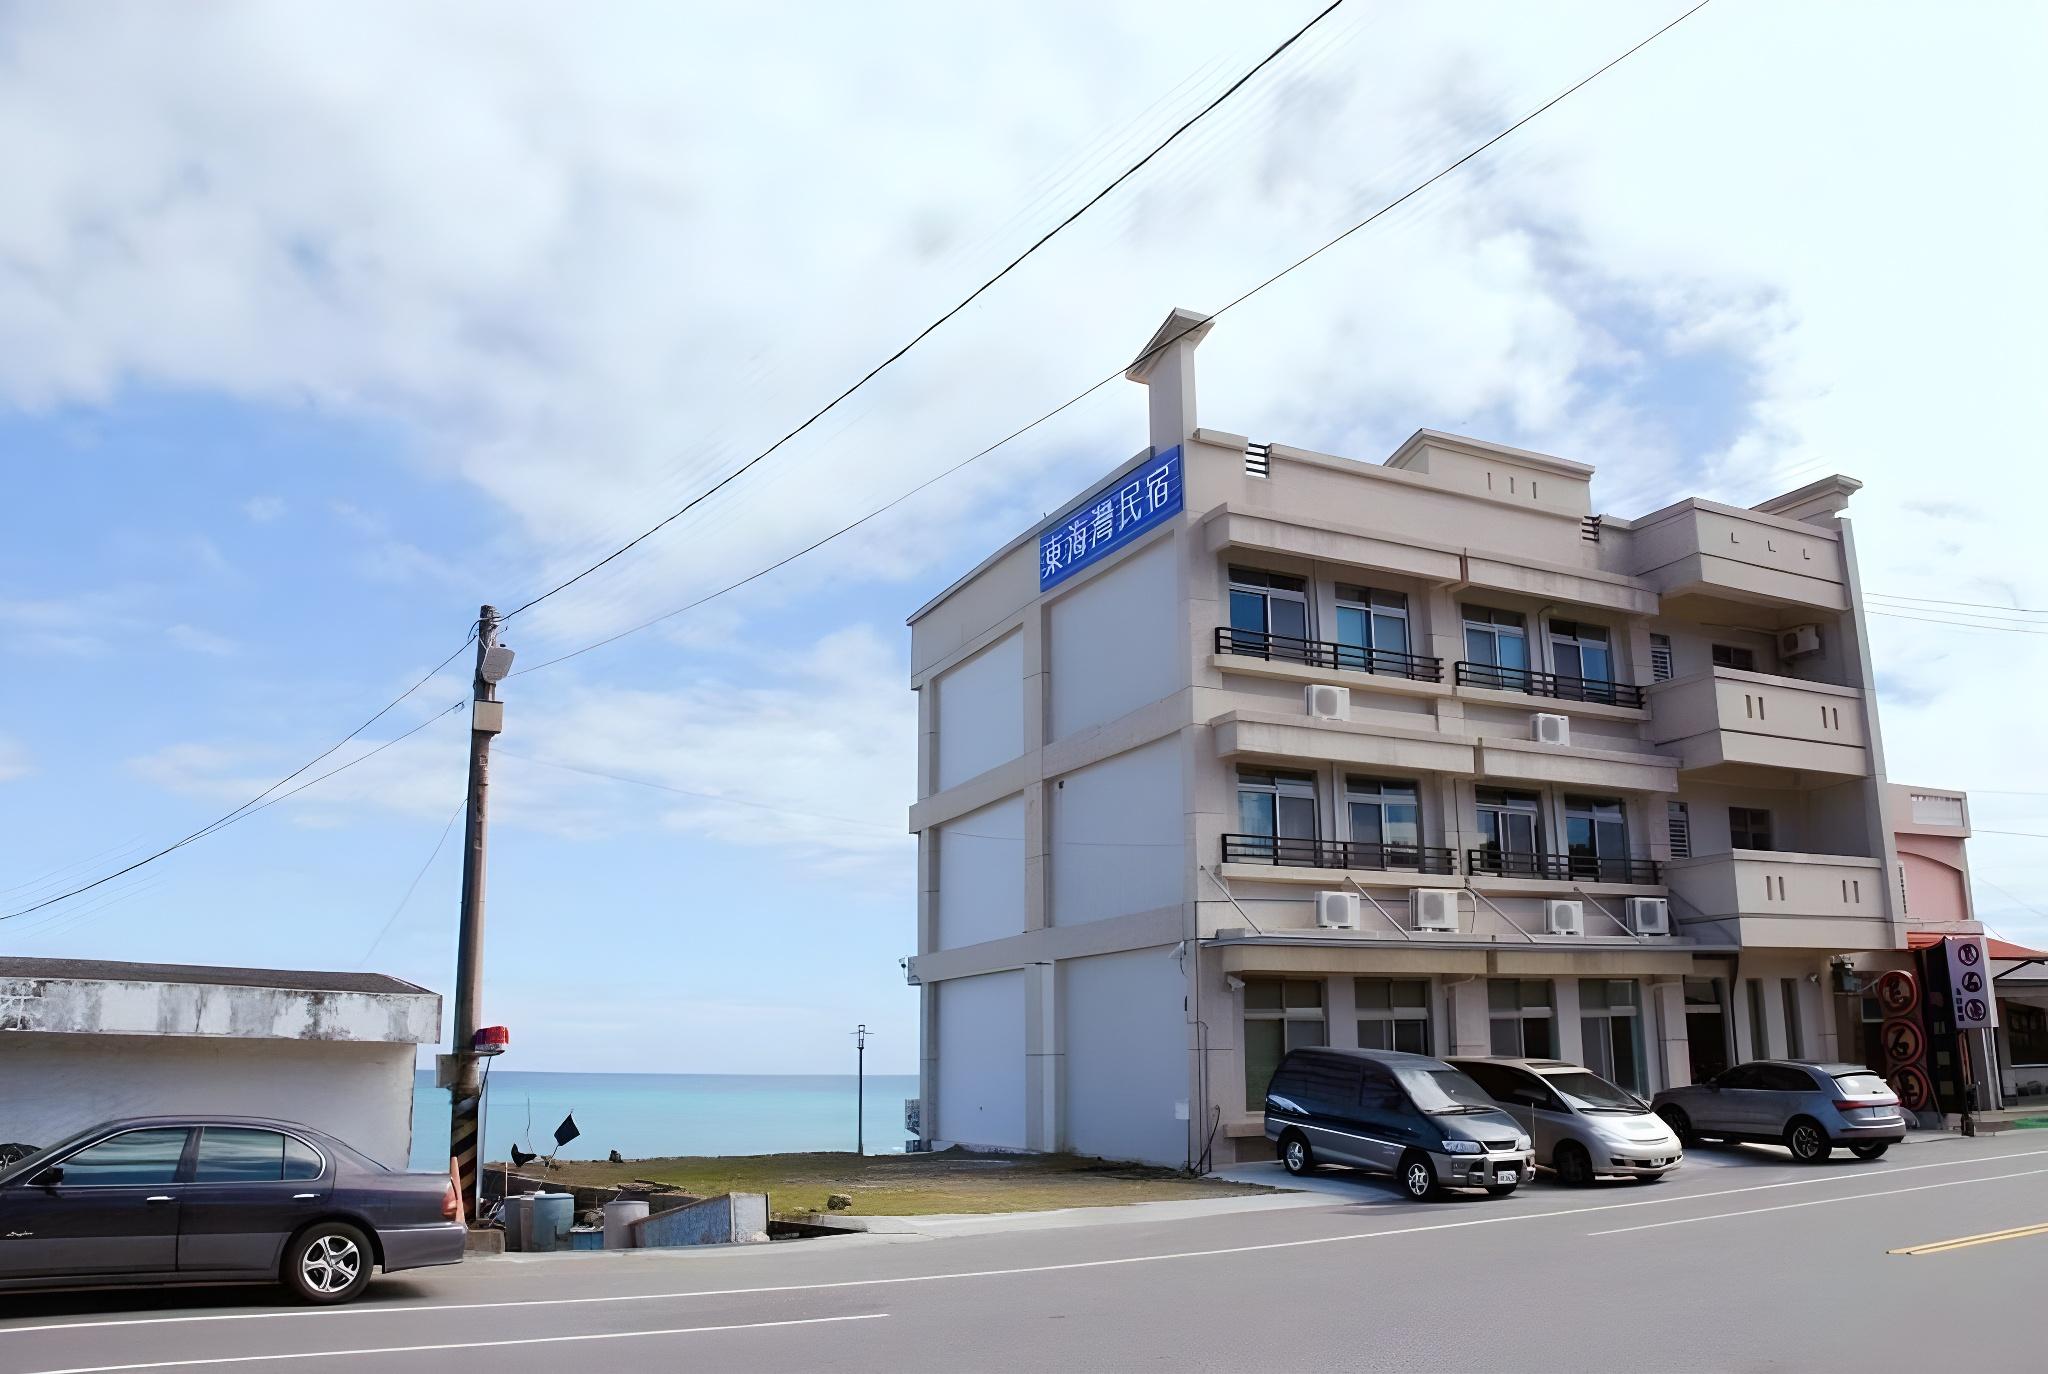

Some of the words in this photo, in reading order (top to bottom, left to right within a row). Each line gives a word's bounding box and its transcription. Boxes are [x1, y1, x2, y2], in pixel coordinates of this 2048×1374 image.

[1041, 464, 1169, 579] 東海灣民宿
